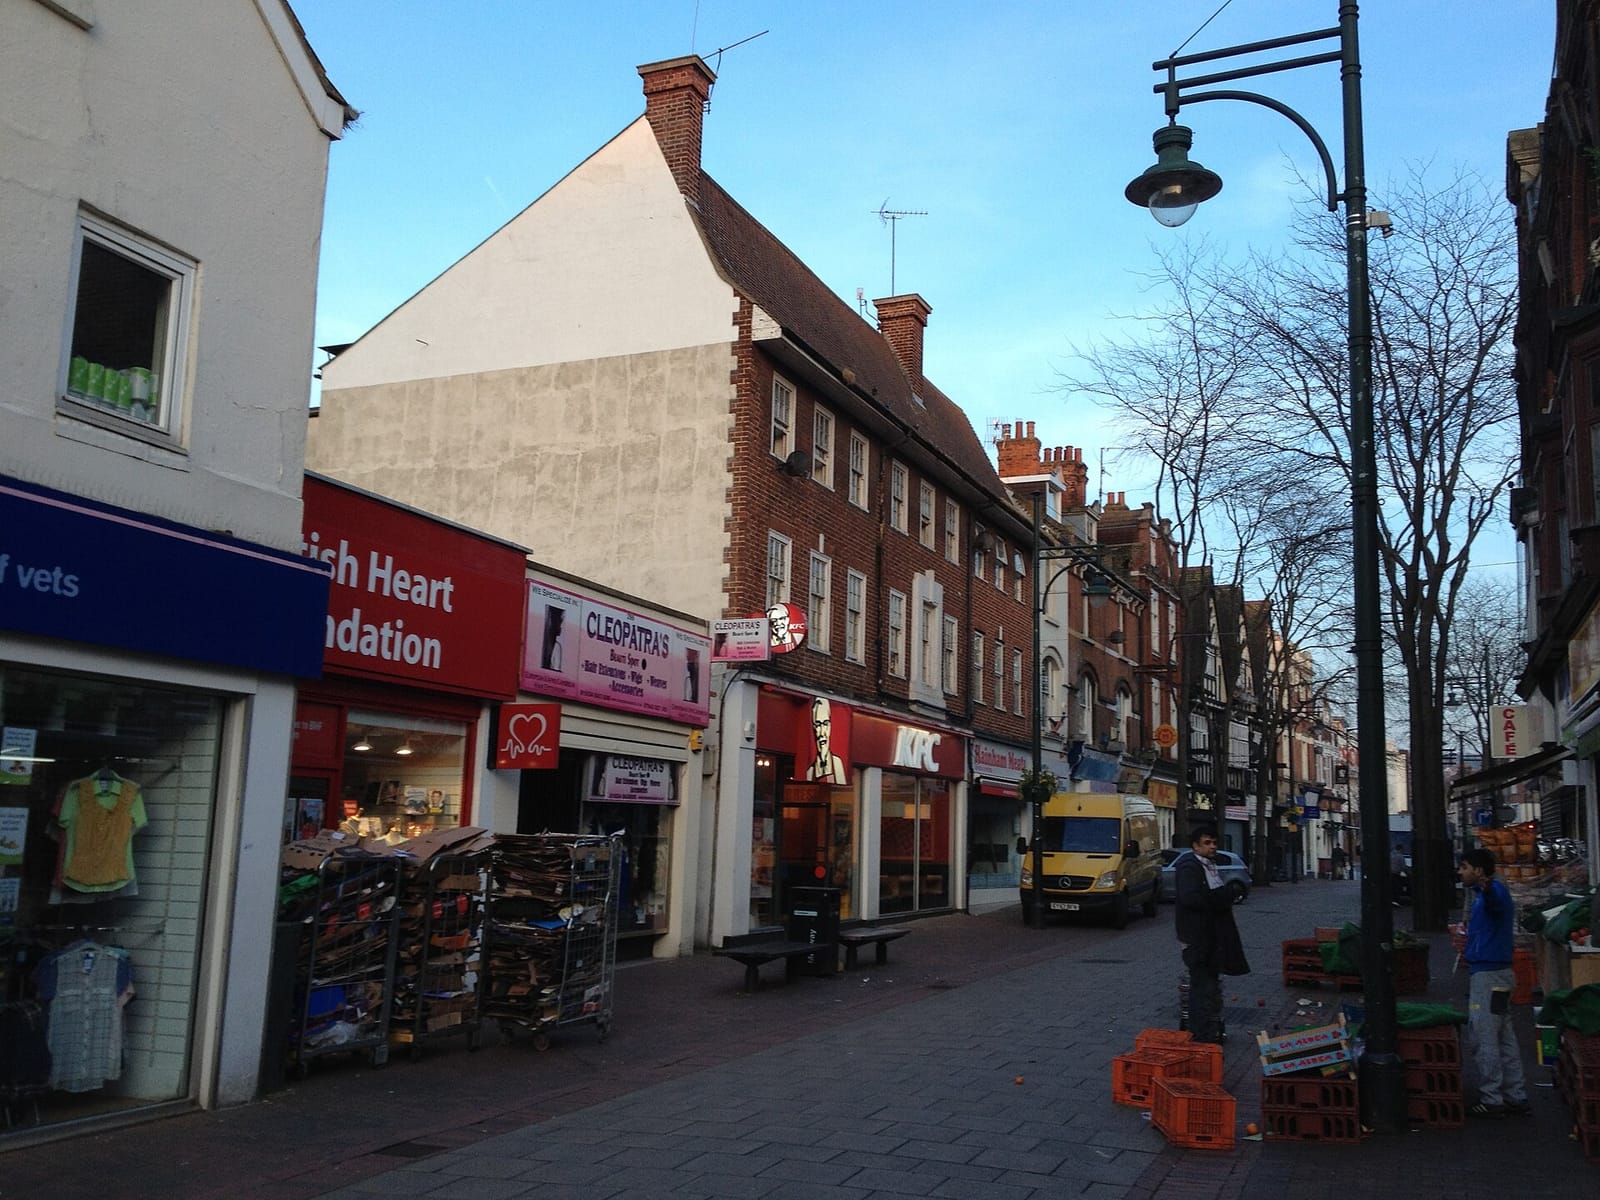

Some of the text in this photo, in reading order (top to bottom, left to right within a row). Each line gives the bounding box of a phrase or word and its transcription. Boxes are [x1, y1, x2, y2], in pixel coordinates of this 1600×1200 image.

[17, 564, 79, 597] vets
[367, 550, 454, 613] Heart
[586, 611, 670, 659] CLEOPATRA'S
[714, 621, 760, 631] CLEOPATRA'S
[893, 726, 942, 772] KFC
